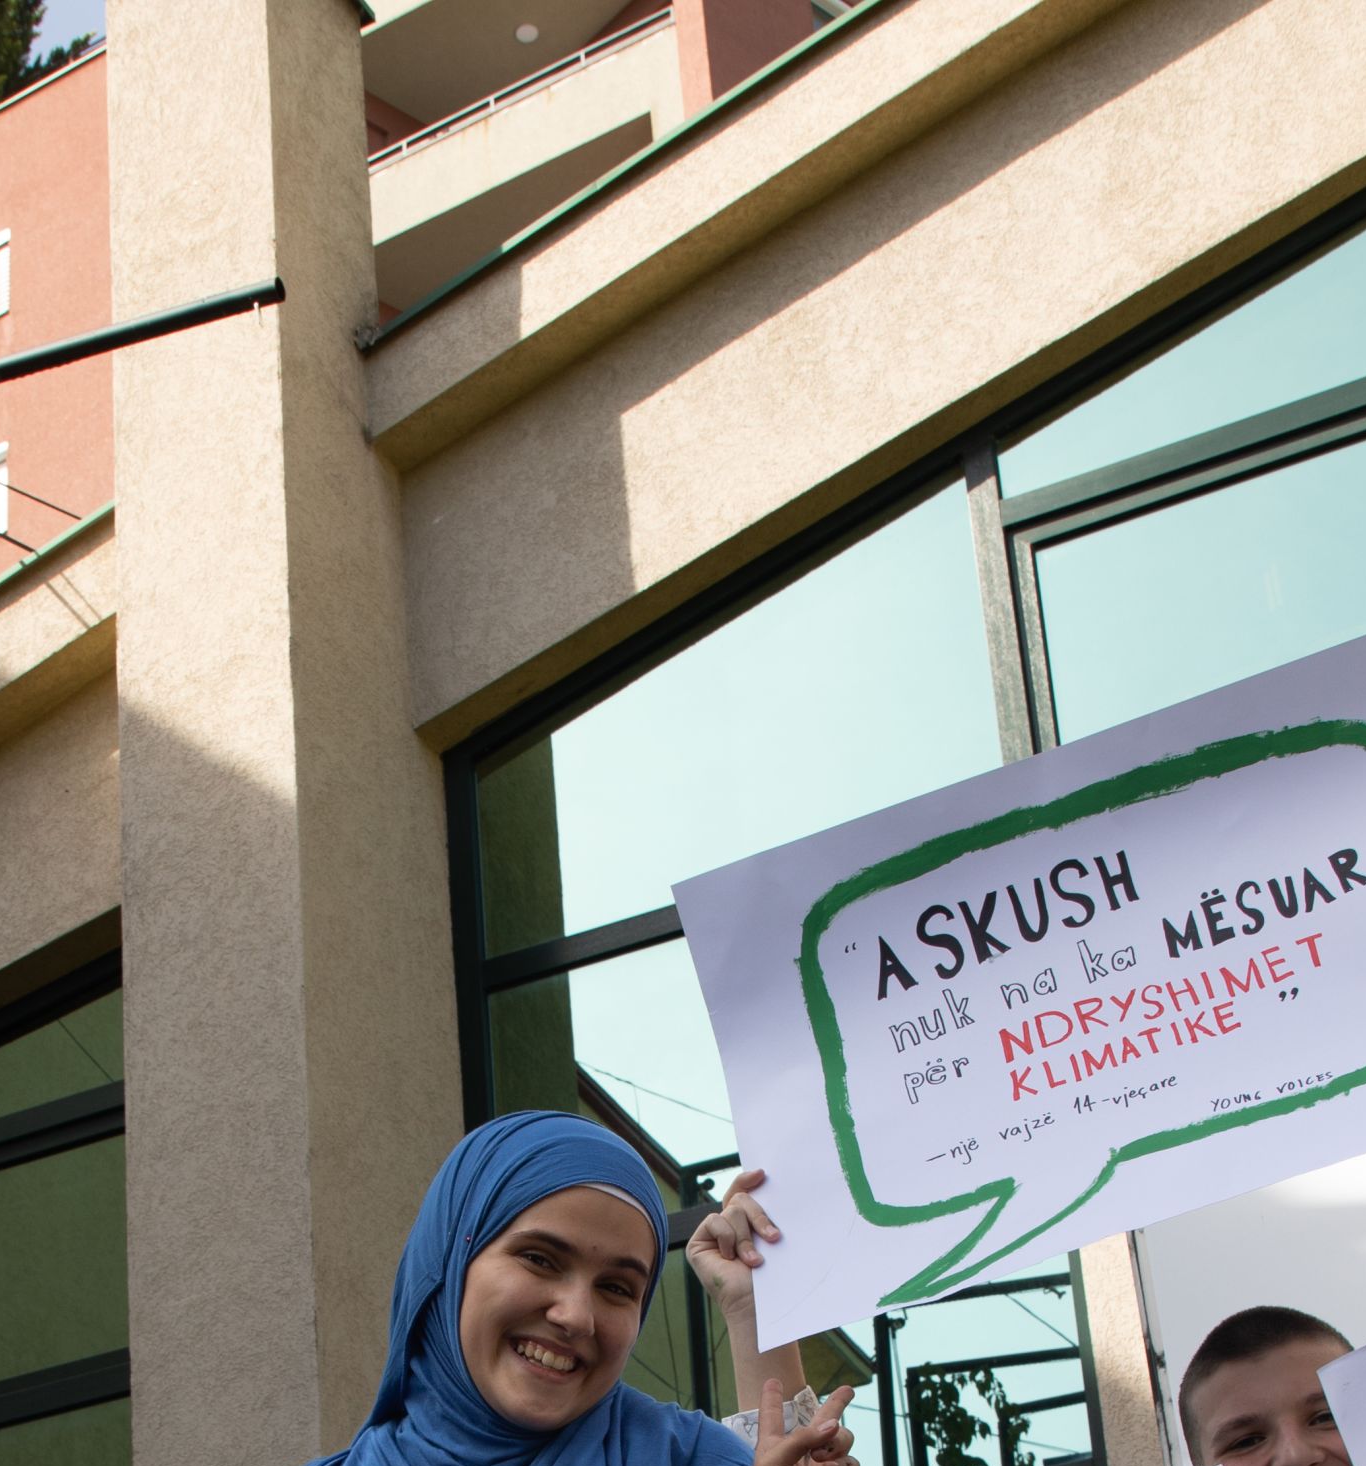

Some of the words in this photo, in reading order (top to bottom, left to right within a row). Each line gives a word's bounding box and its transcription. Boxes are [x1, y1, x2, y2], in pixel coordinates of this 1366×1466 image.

[888, 988, 976, 1054] nuk
[1000, 967, 1058, 1011] na
[1076, 939, 1137, 984] ka
[902, 1052, 970, 1105] për
[997, 931, 1325, 1065] NDRYSHIMET
[998, 1112, 1056, 1142] vajzë
[1072, 1073, 1179, 1116] 14-vjeçare
[1210, 1090, 1263, 1112] YOUNG
[1276, 1069, 1335, 1095] VOICES
